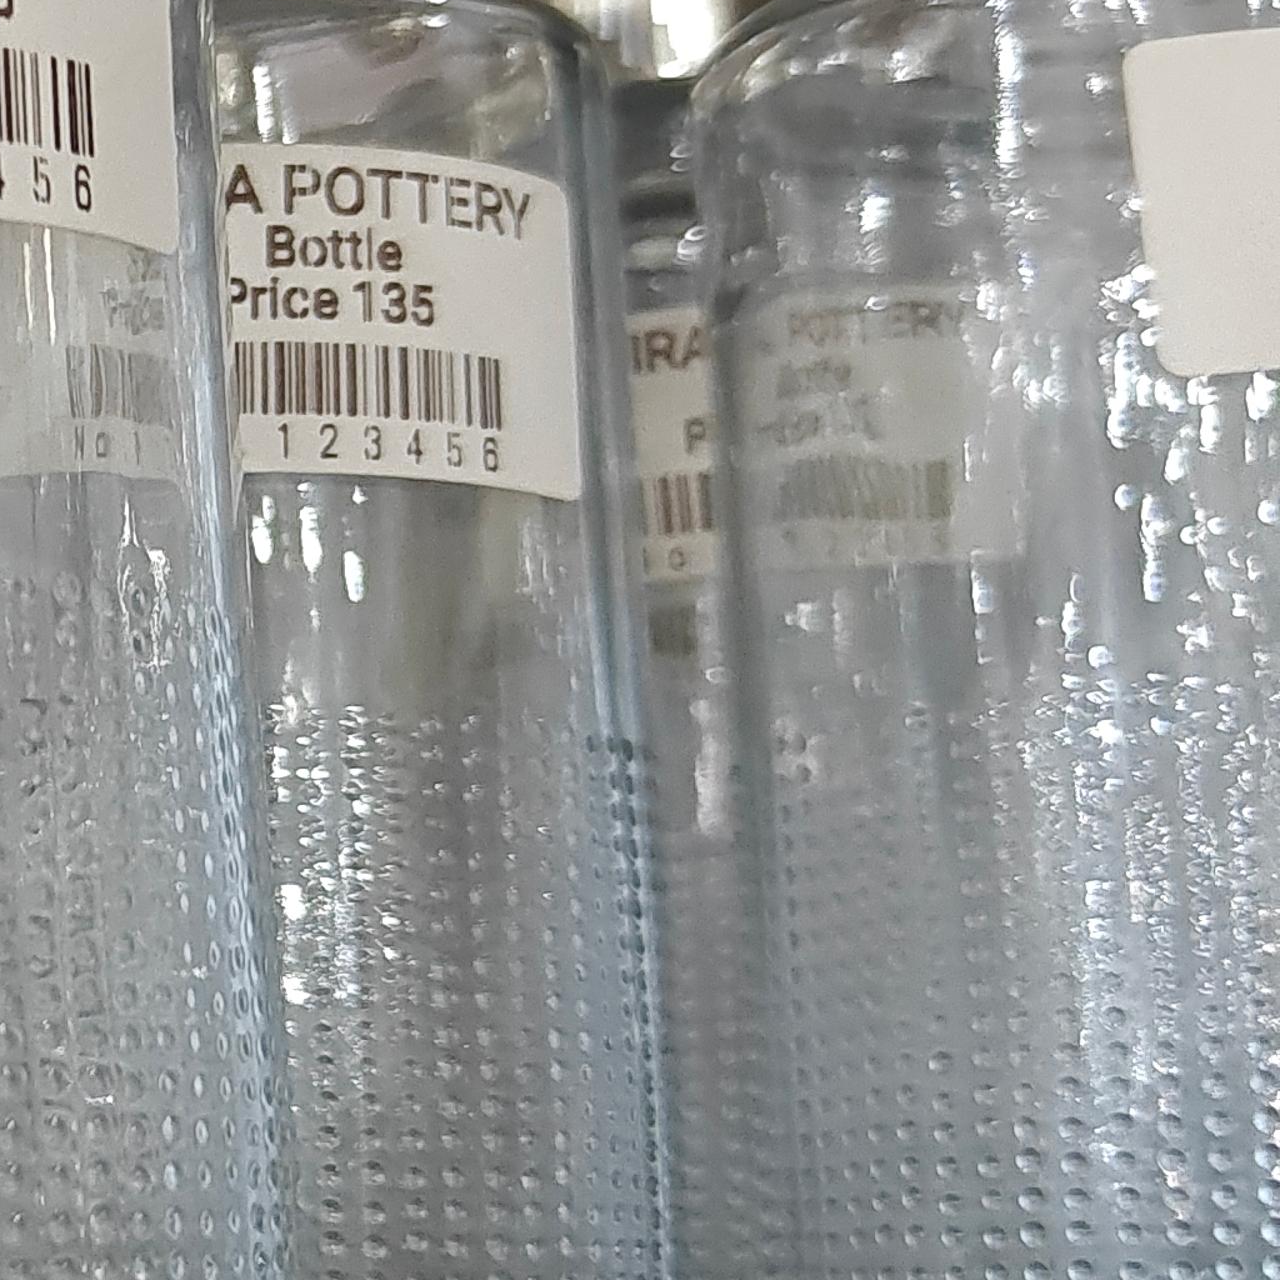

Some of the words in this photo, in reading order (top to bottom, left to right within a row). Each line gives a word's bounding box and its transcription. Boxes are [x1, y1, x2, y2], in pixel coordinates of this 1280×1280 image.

[282, 163, 531, 241] POTTERY
[265, 224, 403, 273] Bottle
[230, 276, 341, 321] Price
[352, 279, 435, 327] 135
